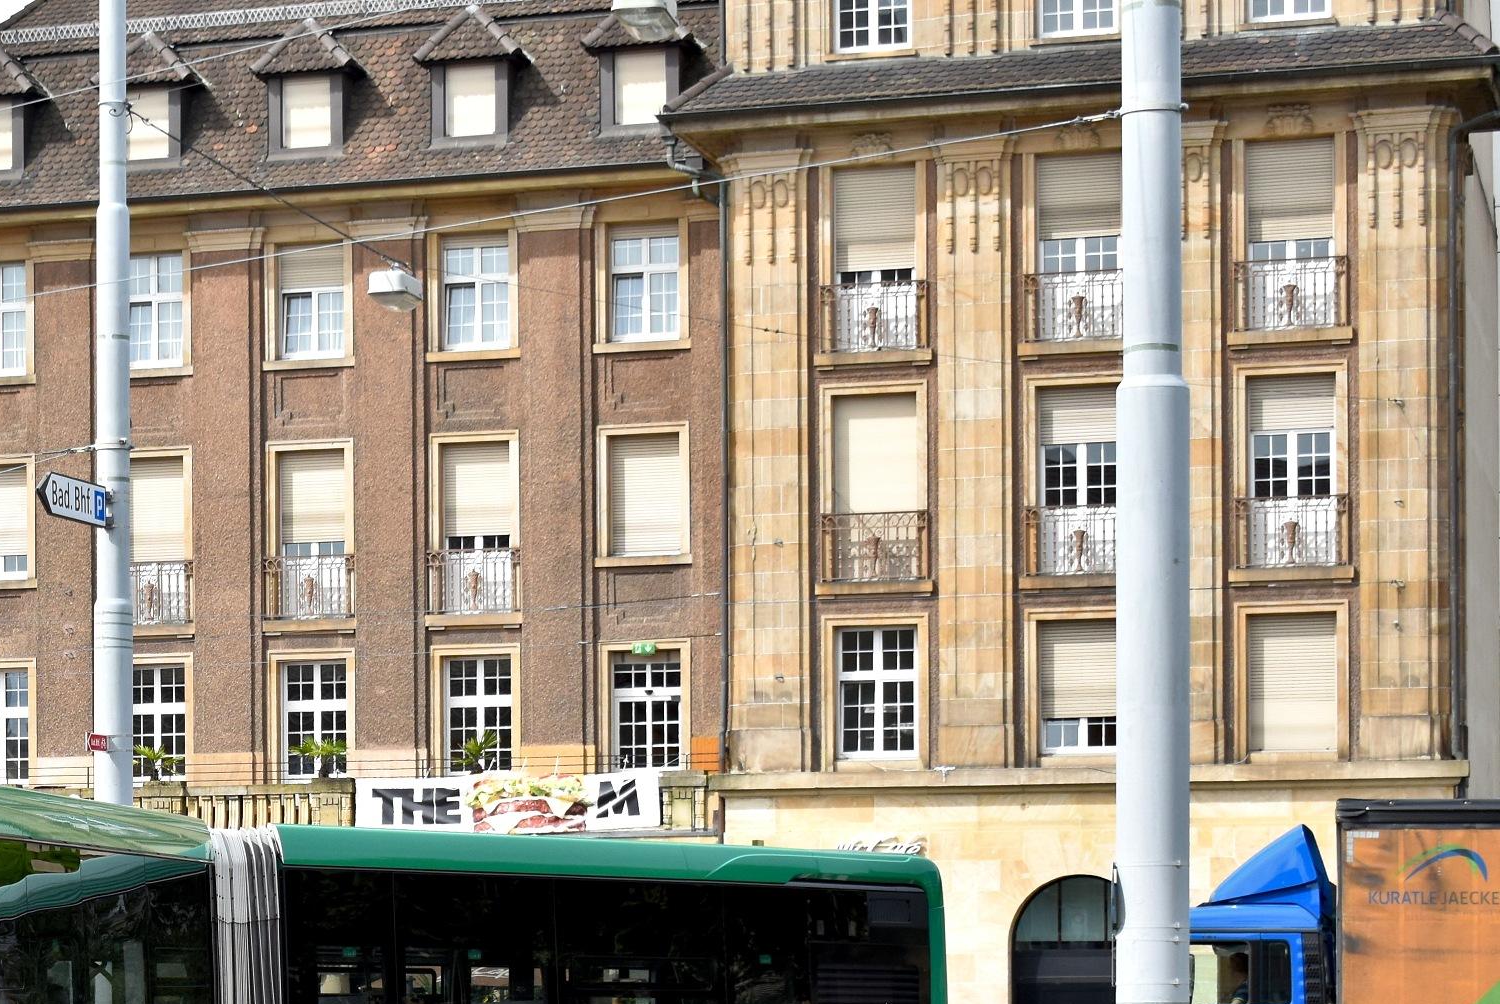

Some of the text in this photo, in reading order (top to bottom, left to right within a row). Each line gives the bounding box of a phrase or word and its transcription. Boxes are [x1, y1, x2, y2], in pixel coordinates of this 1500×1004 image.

[51, 480, 73, 510] Bad.
[74, 486, 92, 515] Bhf.
[372, 787, 461, 825] THE
[1368, 890, 1437, 905] KURATLE
